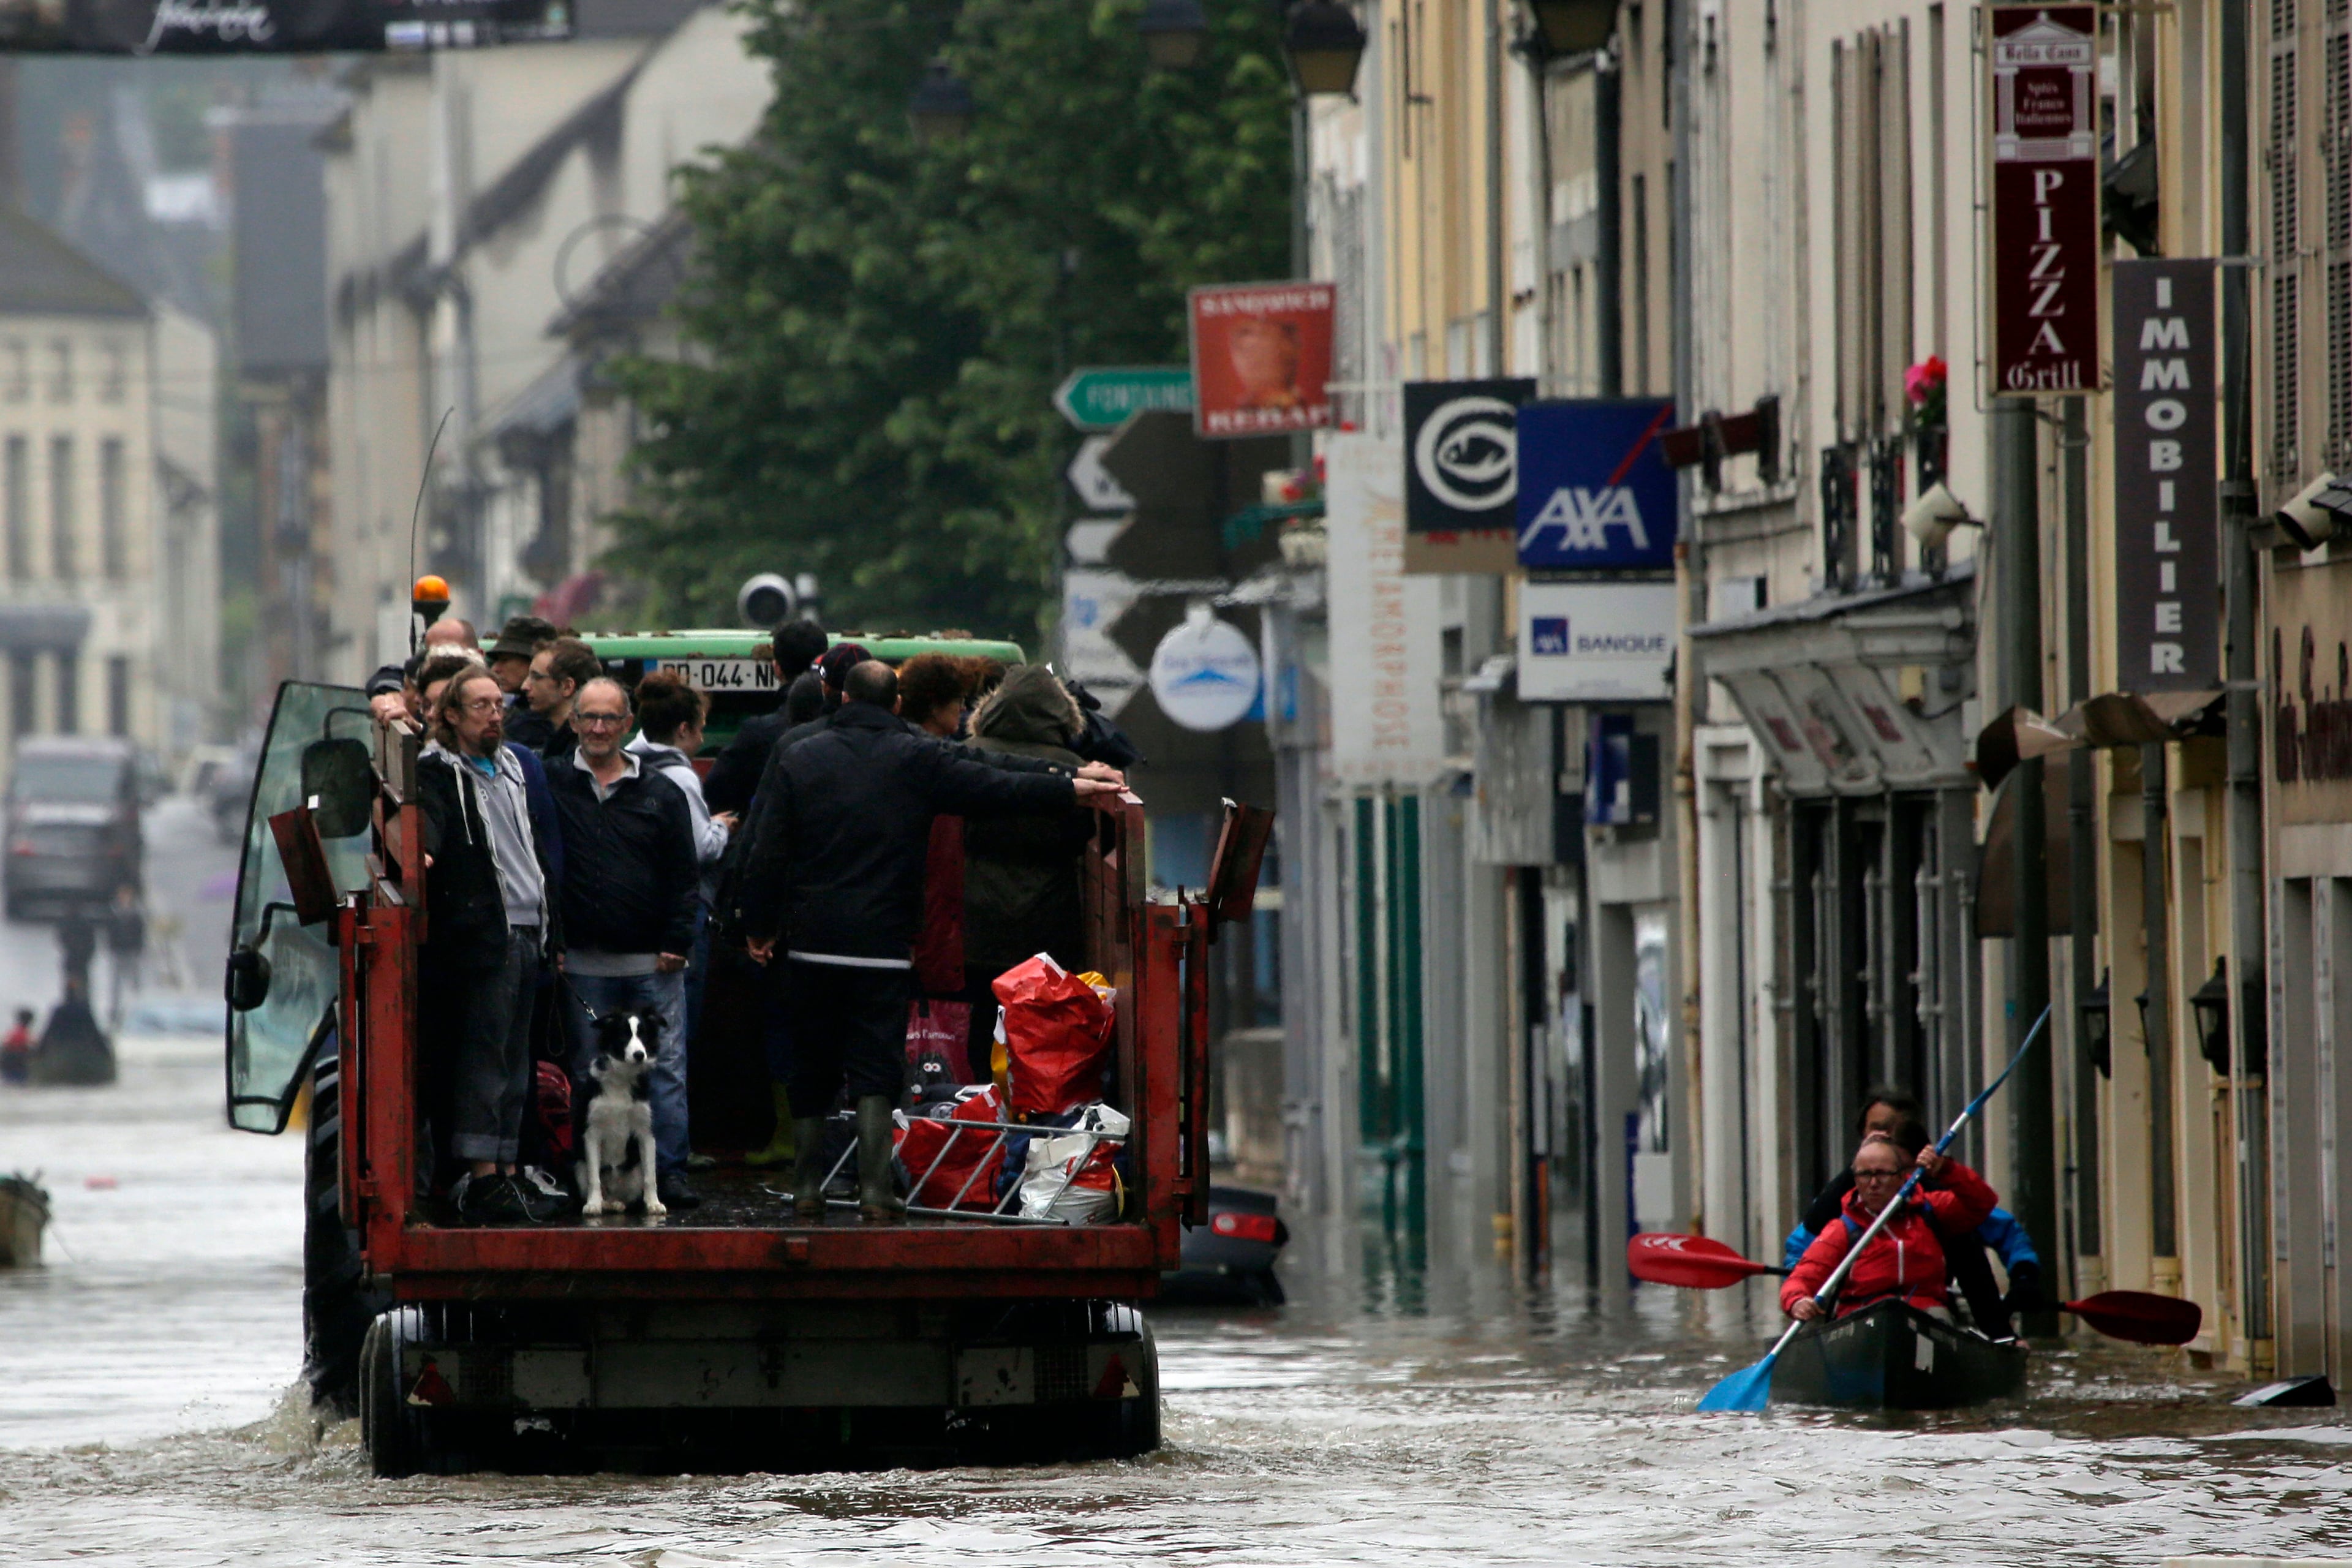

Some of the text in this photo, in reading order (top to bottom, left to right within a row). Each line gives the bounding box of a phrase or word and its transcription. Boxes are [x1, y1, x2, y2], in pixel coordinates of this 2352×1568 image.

[2028, 168, 2066, 355] PIZZA
[1199, 290, 1330, 318] SANDWICH
[2006, 360, 2082, 391] Grill
[2139, 277, 2191, 674] IMMOBILIER
[1518, 486, 1651, 551] AXA
[1577, 633, 1666, 654] BANQUE
